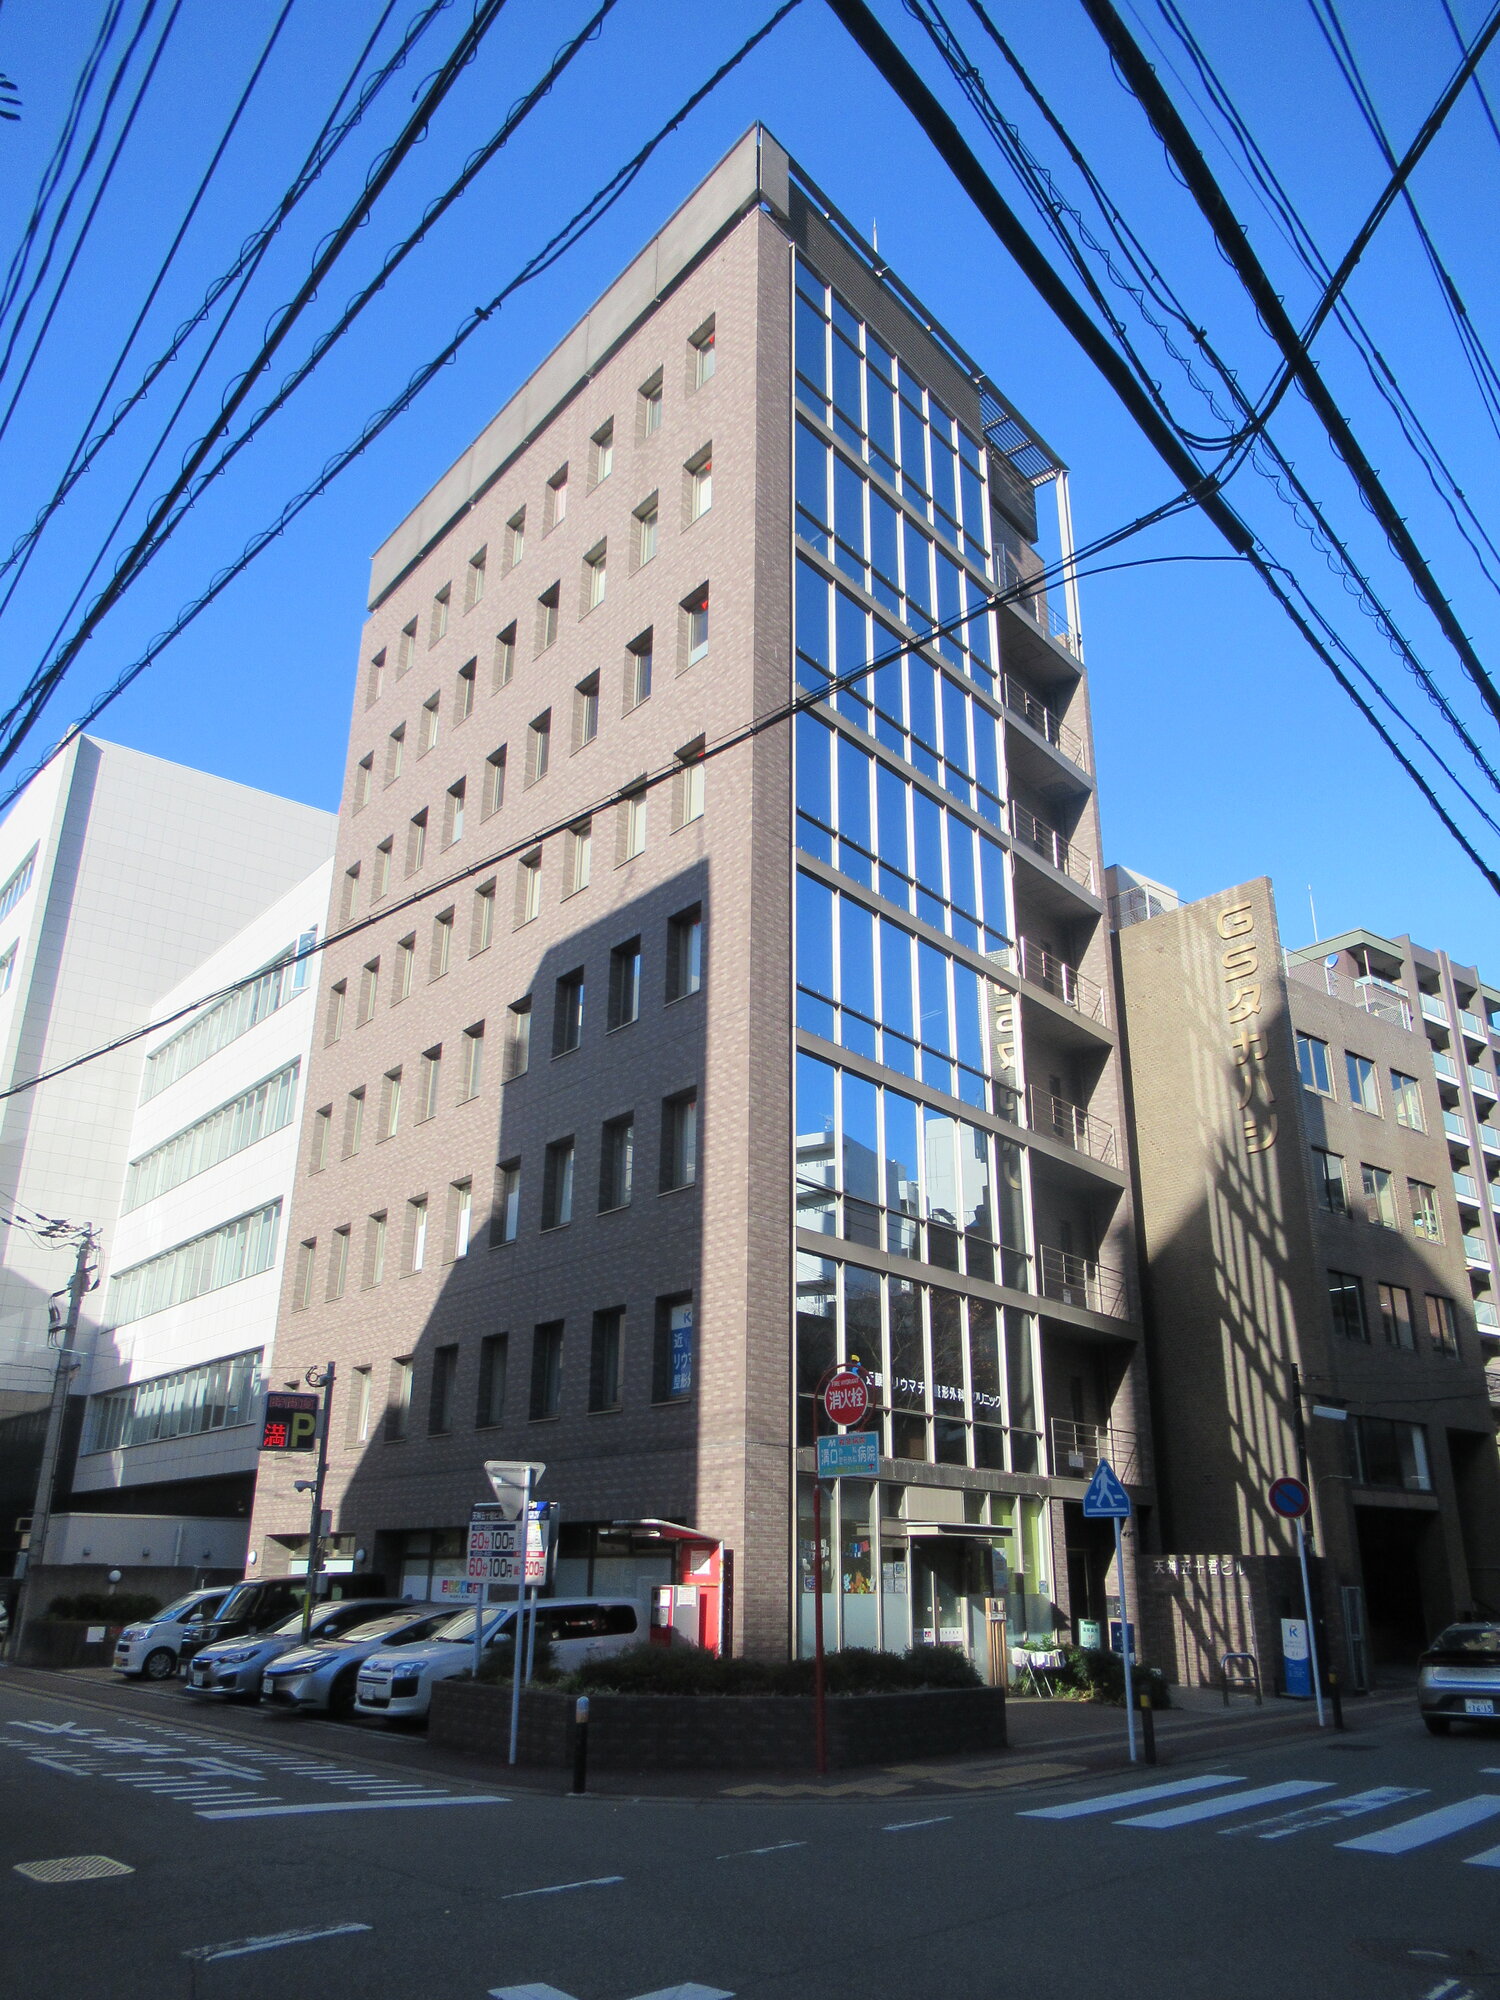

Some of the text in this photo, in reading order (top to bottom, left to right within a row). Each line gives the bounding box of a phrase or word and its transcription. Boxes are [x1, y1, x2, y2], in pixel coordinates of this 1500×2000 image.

[1217, 903, 1278, 1154] GSタカハシ
[829, 1387, 864, 1411] 消火栓
[263, 1423, 286, 1448] 満
[290, 1412, 316, 1448] P
